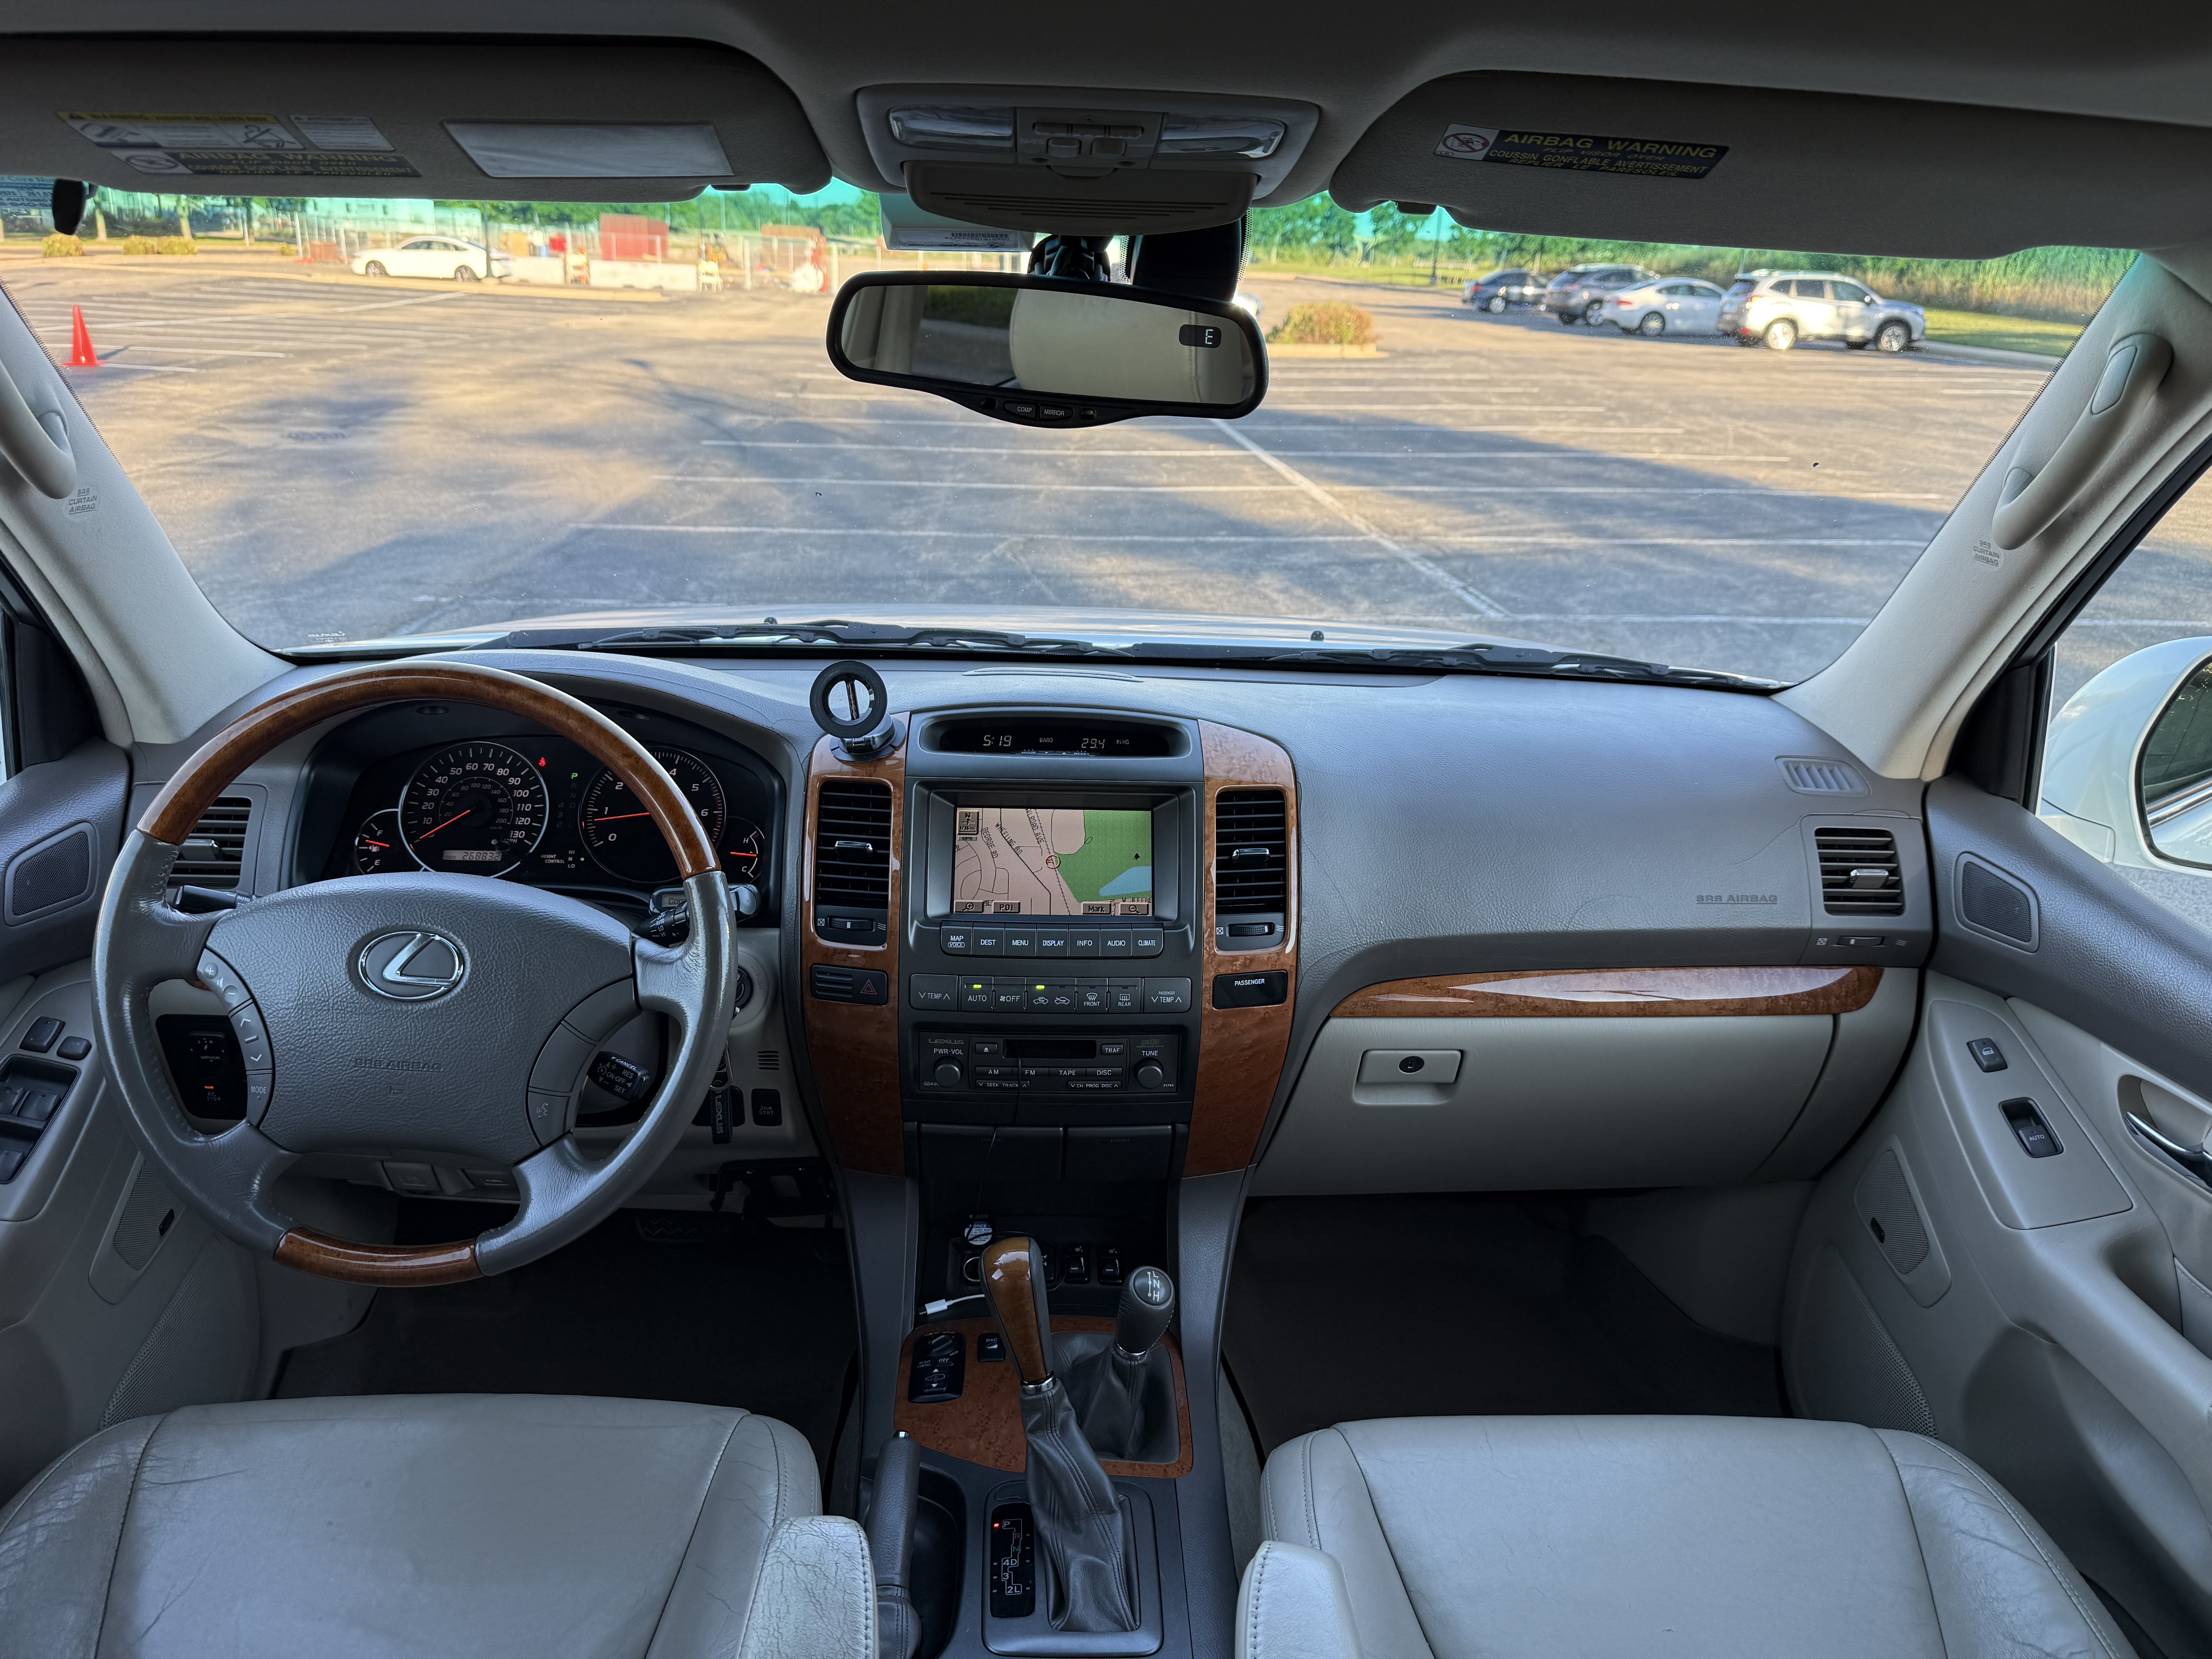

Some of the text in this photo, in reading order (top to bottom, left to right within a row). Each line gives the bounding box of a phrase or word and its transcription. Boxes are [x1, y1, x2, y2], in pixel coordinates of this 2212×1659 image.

[1504, 134, 1717, 158] AIRBAG WARNING
[280, 154, 397, 162] WARNING
[1489, 150, 1708, 173] COUSSIN GONFLABLE AVERTISSEMENT
[1508, 159, 1563, 167] REPLIER
[1598, 165, 1678, 177] PARESOLEIL
[1206, 329, 1213, 344] E
[69, 495, 97, 505] CURTAIN
[69, 503, 96, 513] AIRBAG
[1979, 540, 1991, 548] SRS
[1973, 546, 1999, 559] CURTAIN
[1974, 553, 1998, 566] AIRBAG
[983, 735, 1012, 747] 5:19
[1082, 738, 1105, 749] 29.4
[450, 767, 462, 775] 50
[466, 763, 479, 771] 60
[496, 768, 509, 776] 80
[508, 777, 521, 785] 90
[691, 783, 699, 792] 5
[422, 817, 433, 825] 10
[510, 830, 526, 838] 130
[608, 833, 617, 841] 0
[1035, 832, 1044, 844] AVE
[462, 852, 500, 860] 268832
[991, 850, 999, 859] RD
[756, 973, 764, 991] PUSH
[1234, 978, 1265, 986] PASSENGER
[616, 1059, 637, 1070] CANCEL
[622, 1069, 634, 1079] RES
[251, 1085, 267, 1094] MODE
[614, 1085, 626, 1094] SET
[715, 1094, 723, 1133] LEXUS
[1153, 1279, 1160, 1288] N
[1153, 1290, 1159, 1302] H
